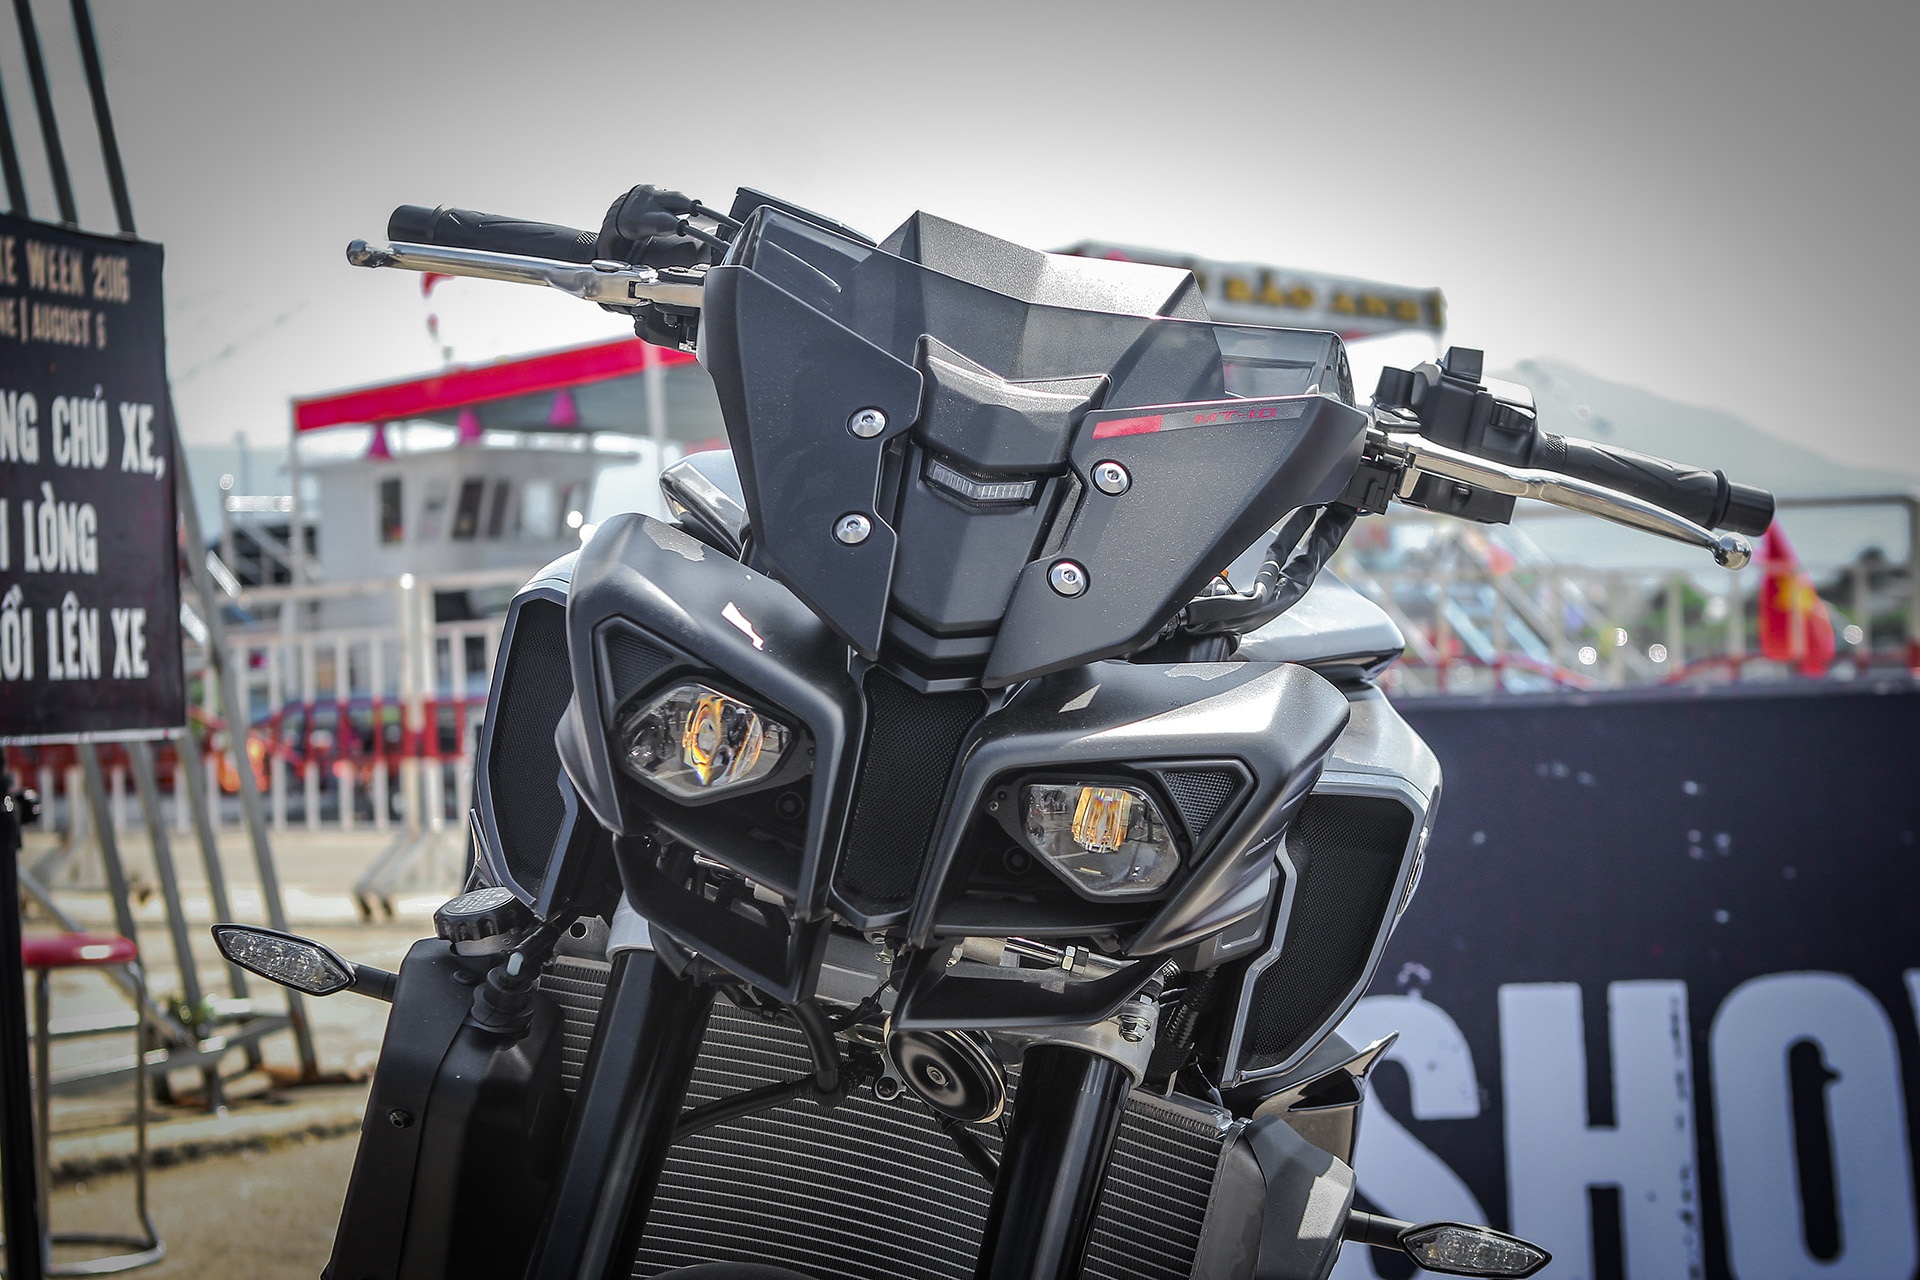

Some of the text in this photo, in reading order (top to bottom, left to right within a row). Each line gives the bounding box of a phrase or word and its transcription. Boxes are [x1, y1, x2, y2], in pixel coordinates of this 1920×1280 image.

[26, 239, 84, 297] WEEK
[92, 254, 130, 303] 2016
[32, 302, 90, 348] AUGUST
[119, 401, 166, 480] XE,
[1193, 407, 1277, 425] MT-10
[22, 481, 99, 574] LÒNG
[46, 591, 101, 681] LÊN
[110, 608, 149, 679] XE
[1329, 967, 1920, 1280] SHO
